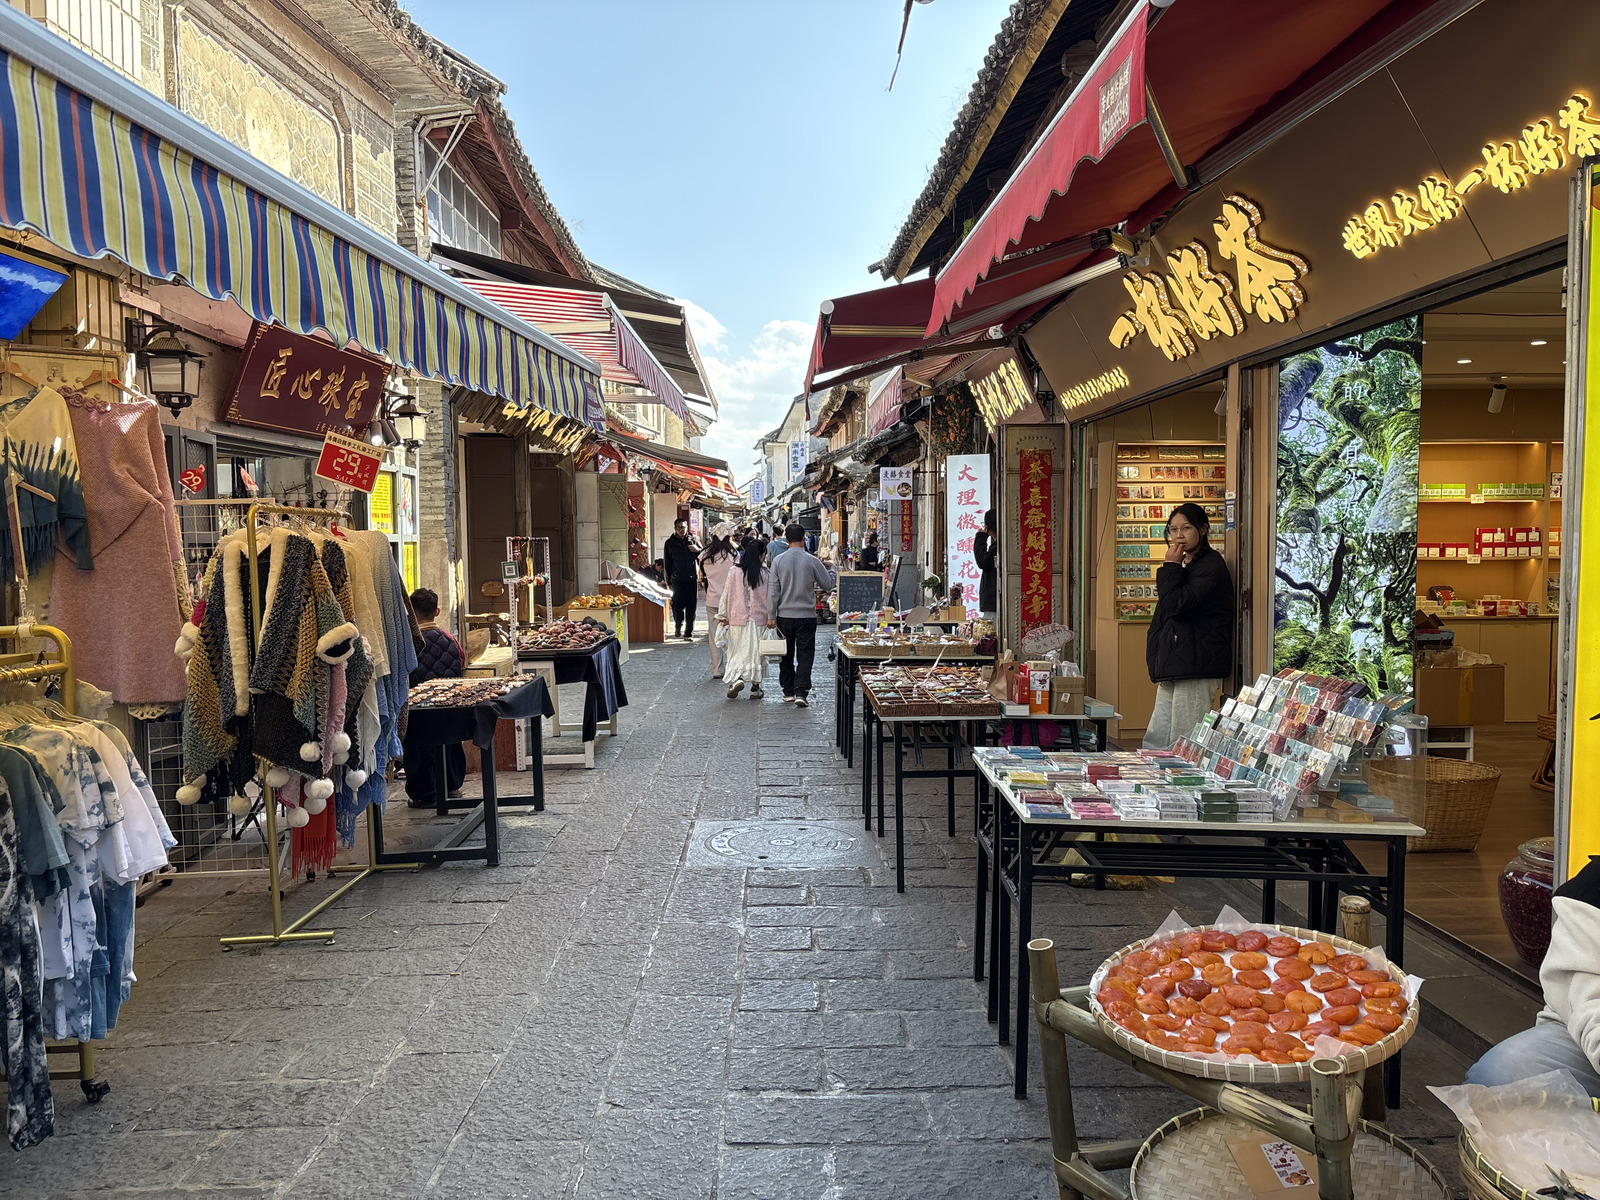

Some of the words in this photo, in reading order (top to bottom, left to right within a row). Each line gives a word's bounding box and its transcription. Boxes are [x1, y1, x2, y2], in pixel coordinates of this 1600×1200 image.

[1342, 94, 1600, 260] 世界欠你一杯好茶
[1107, 193, 1310, 362] 一杯好茶
[259, 347, 370, 420] 匠心珠宝
[335, 474, 355, 485] SALE
